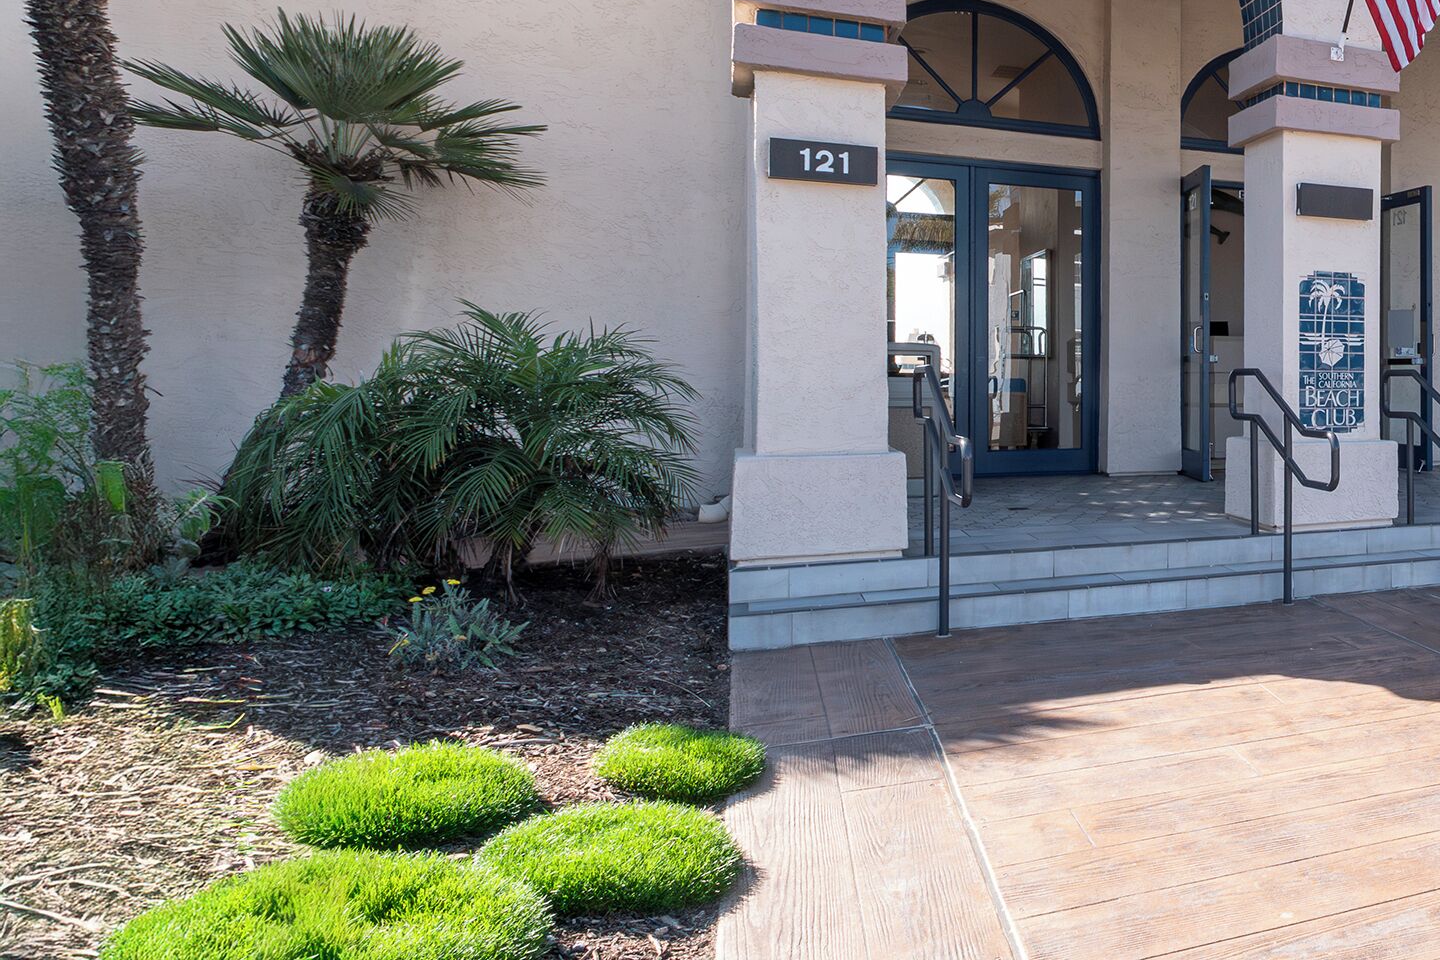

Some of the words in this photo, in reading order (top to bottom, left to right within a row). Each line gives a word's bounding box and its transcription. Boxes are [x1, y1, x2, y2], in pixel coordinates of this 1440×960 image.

[800, 147, 849, 174] 121
[1303, 375, 1316, 385] THE
[1318, 372, 1354, 381] SOUTHERN
[1318, 380, 1357, 389] CALIFORNIA
[1305, 385, 1360, 407] BEACH
[1311, 408, 1356, 430] CLUB
